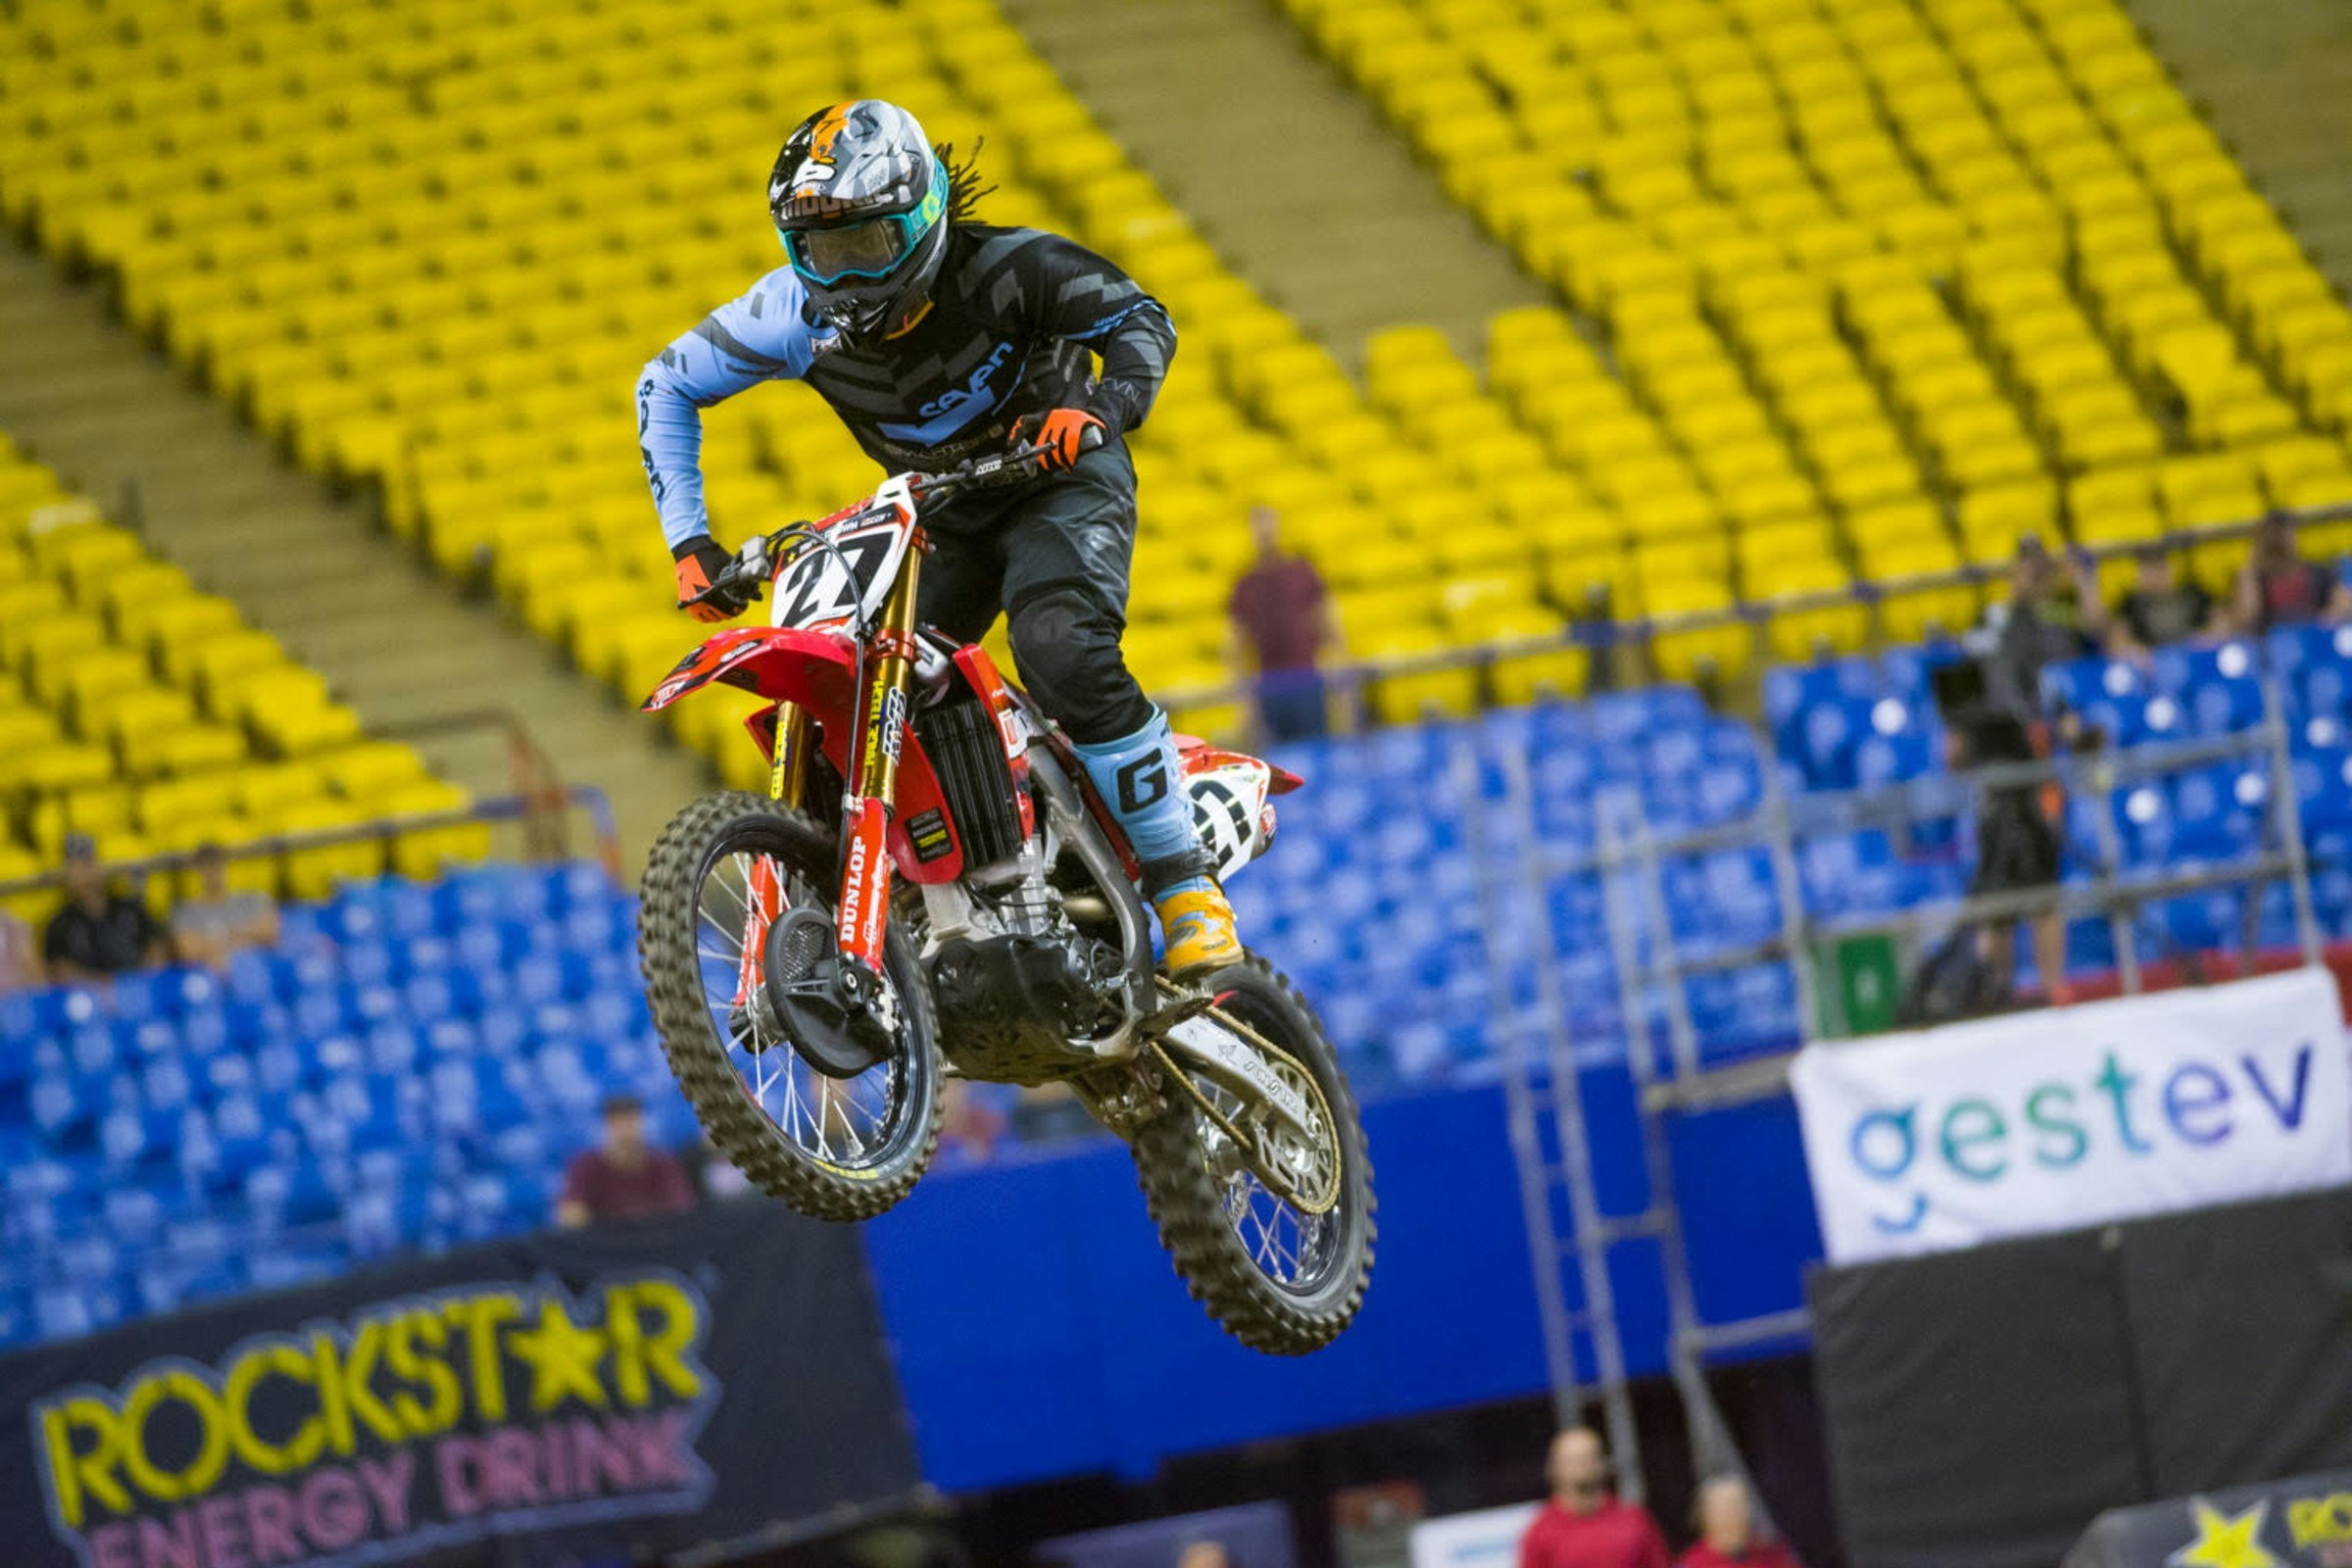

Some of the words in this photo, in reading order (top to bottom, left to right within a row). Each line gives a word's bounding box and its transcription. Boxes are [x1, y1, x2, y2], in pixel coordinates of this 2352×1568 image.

[911, 341, 1014, 423] seven
[780, 530, 895, 628] 27
[1116, 747, 1168, 814] G
[840, 836, 867, 944] DUNLOP
[1848, 1042, 2313, 1235] gestev
[86, 1456, 416, 1568] ENERGY
[438, 1413, 687, 1518] DRINK
